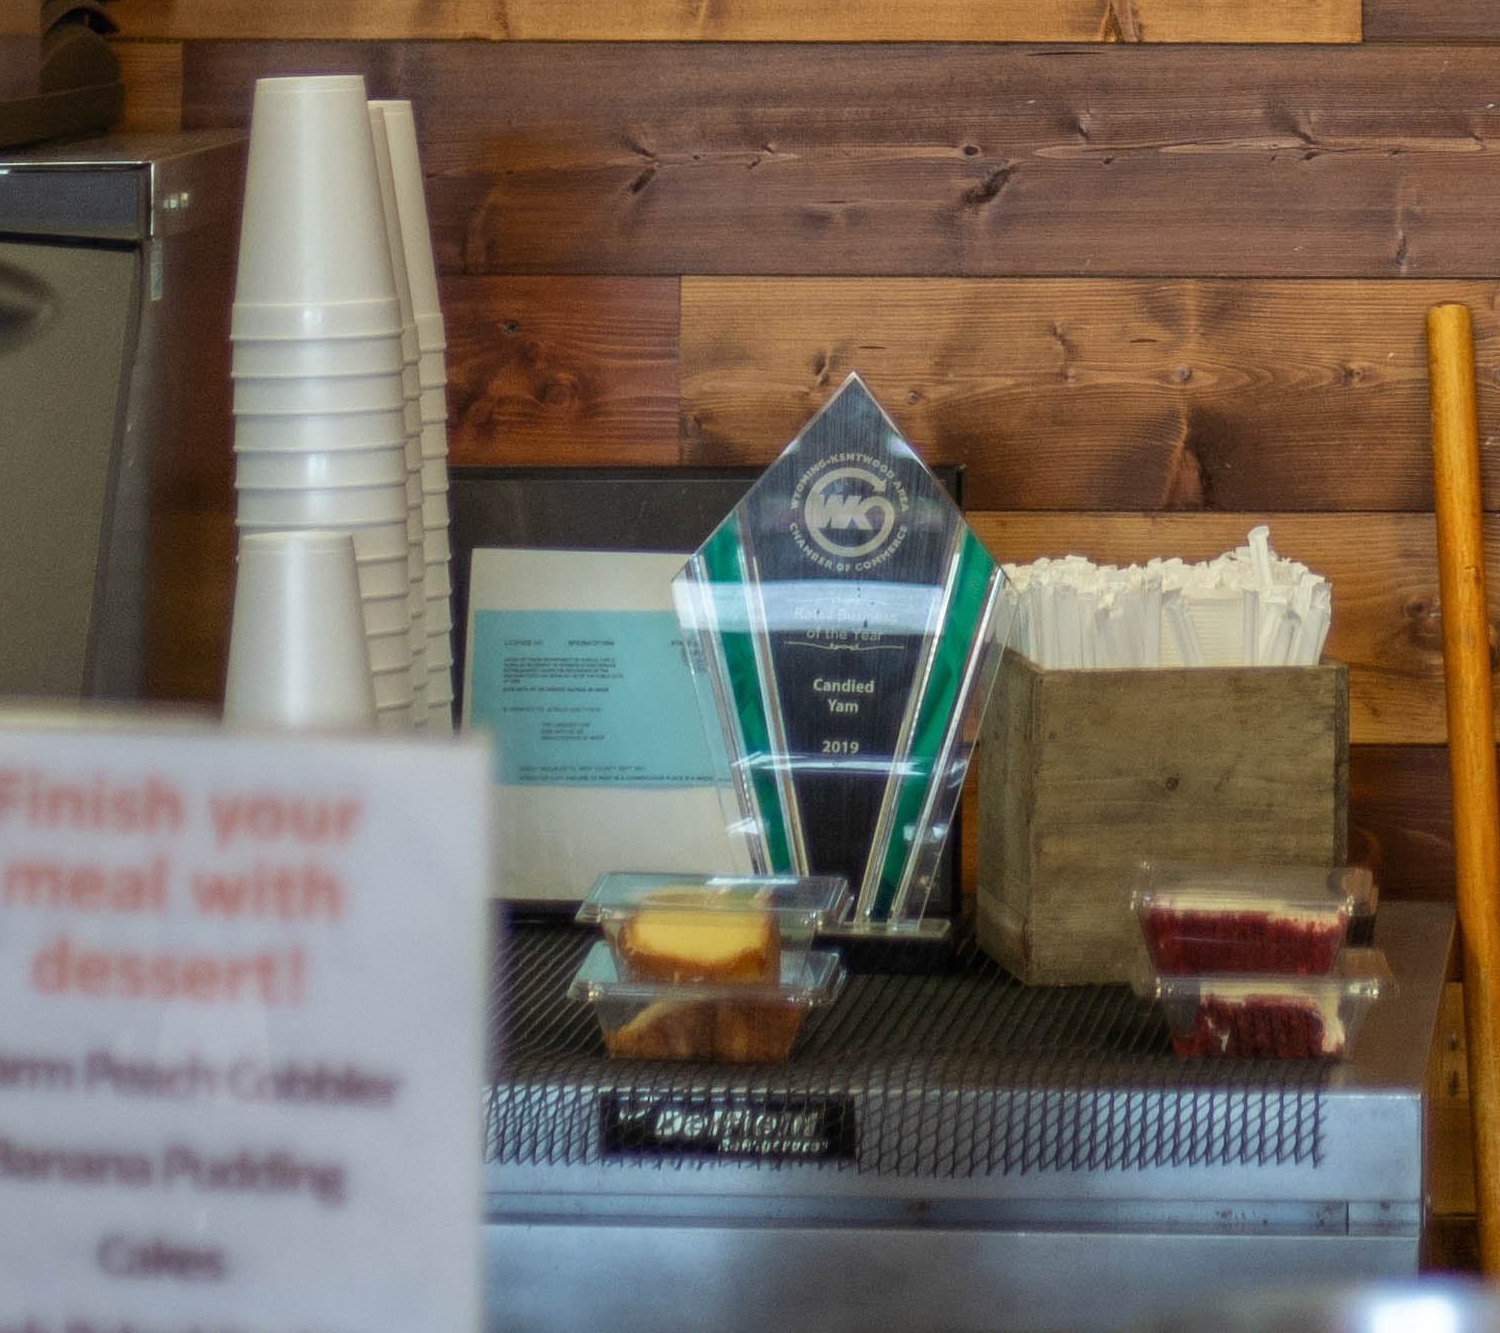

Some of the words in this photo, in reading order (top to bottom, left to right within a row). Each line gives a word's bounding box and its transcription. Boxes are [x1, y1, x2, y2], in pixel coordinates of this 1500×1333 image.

[789, 521, 834, 571] CHAMBER
[835, 562, 851, 573] OF
[853, 524, 910, 572] COMMERCE
[806, 627, 821, 640] of
[825, 627, 848, 641] the
[851, 628, 884, 642] Year
[812, 677, 876, 694] Candied
[827, 698, 860, 714] Yam
[821, 739, 860, 754] 2019
[206, 791, 363, 848] your
[2, 854, 168, 914] meal
[192, 860, 345, 921] with
[30, 937, 310, 1008] dessert!
[163, 1141, 348, 1211] Pudding
